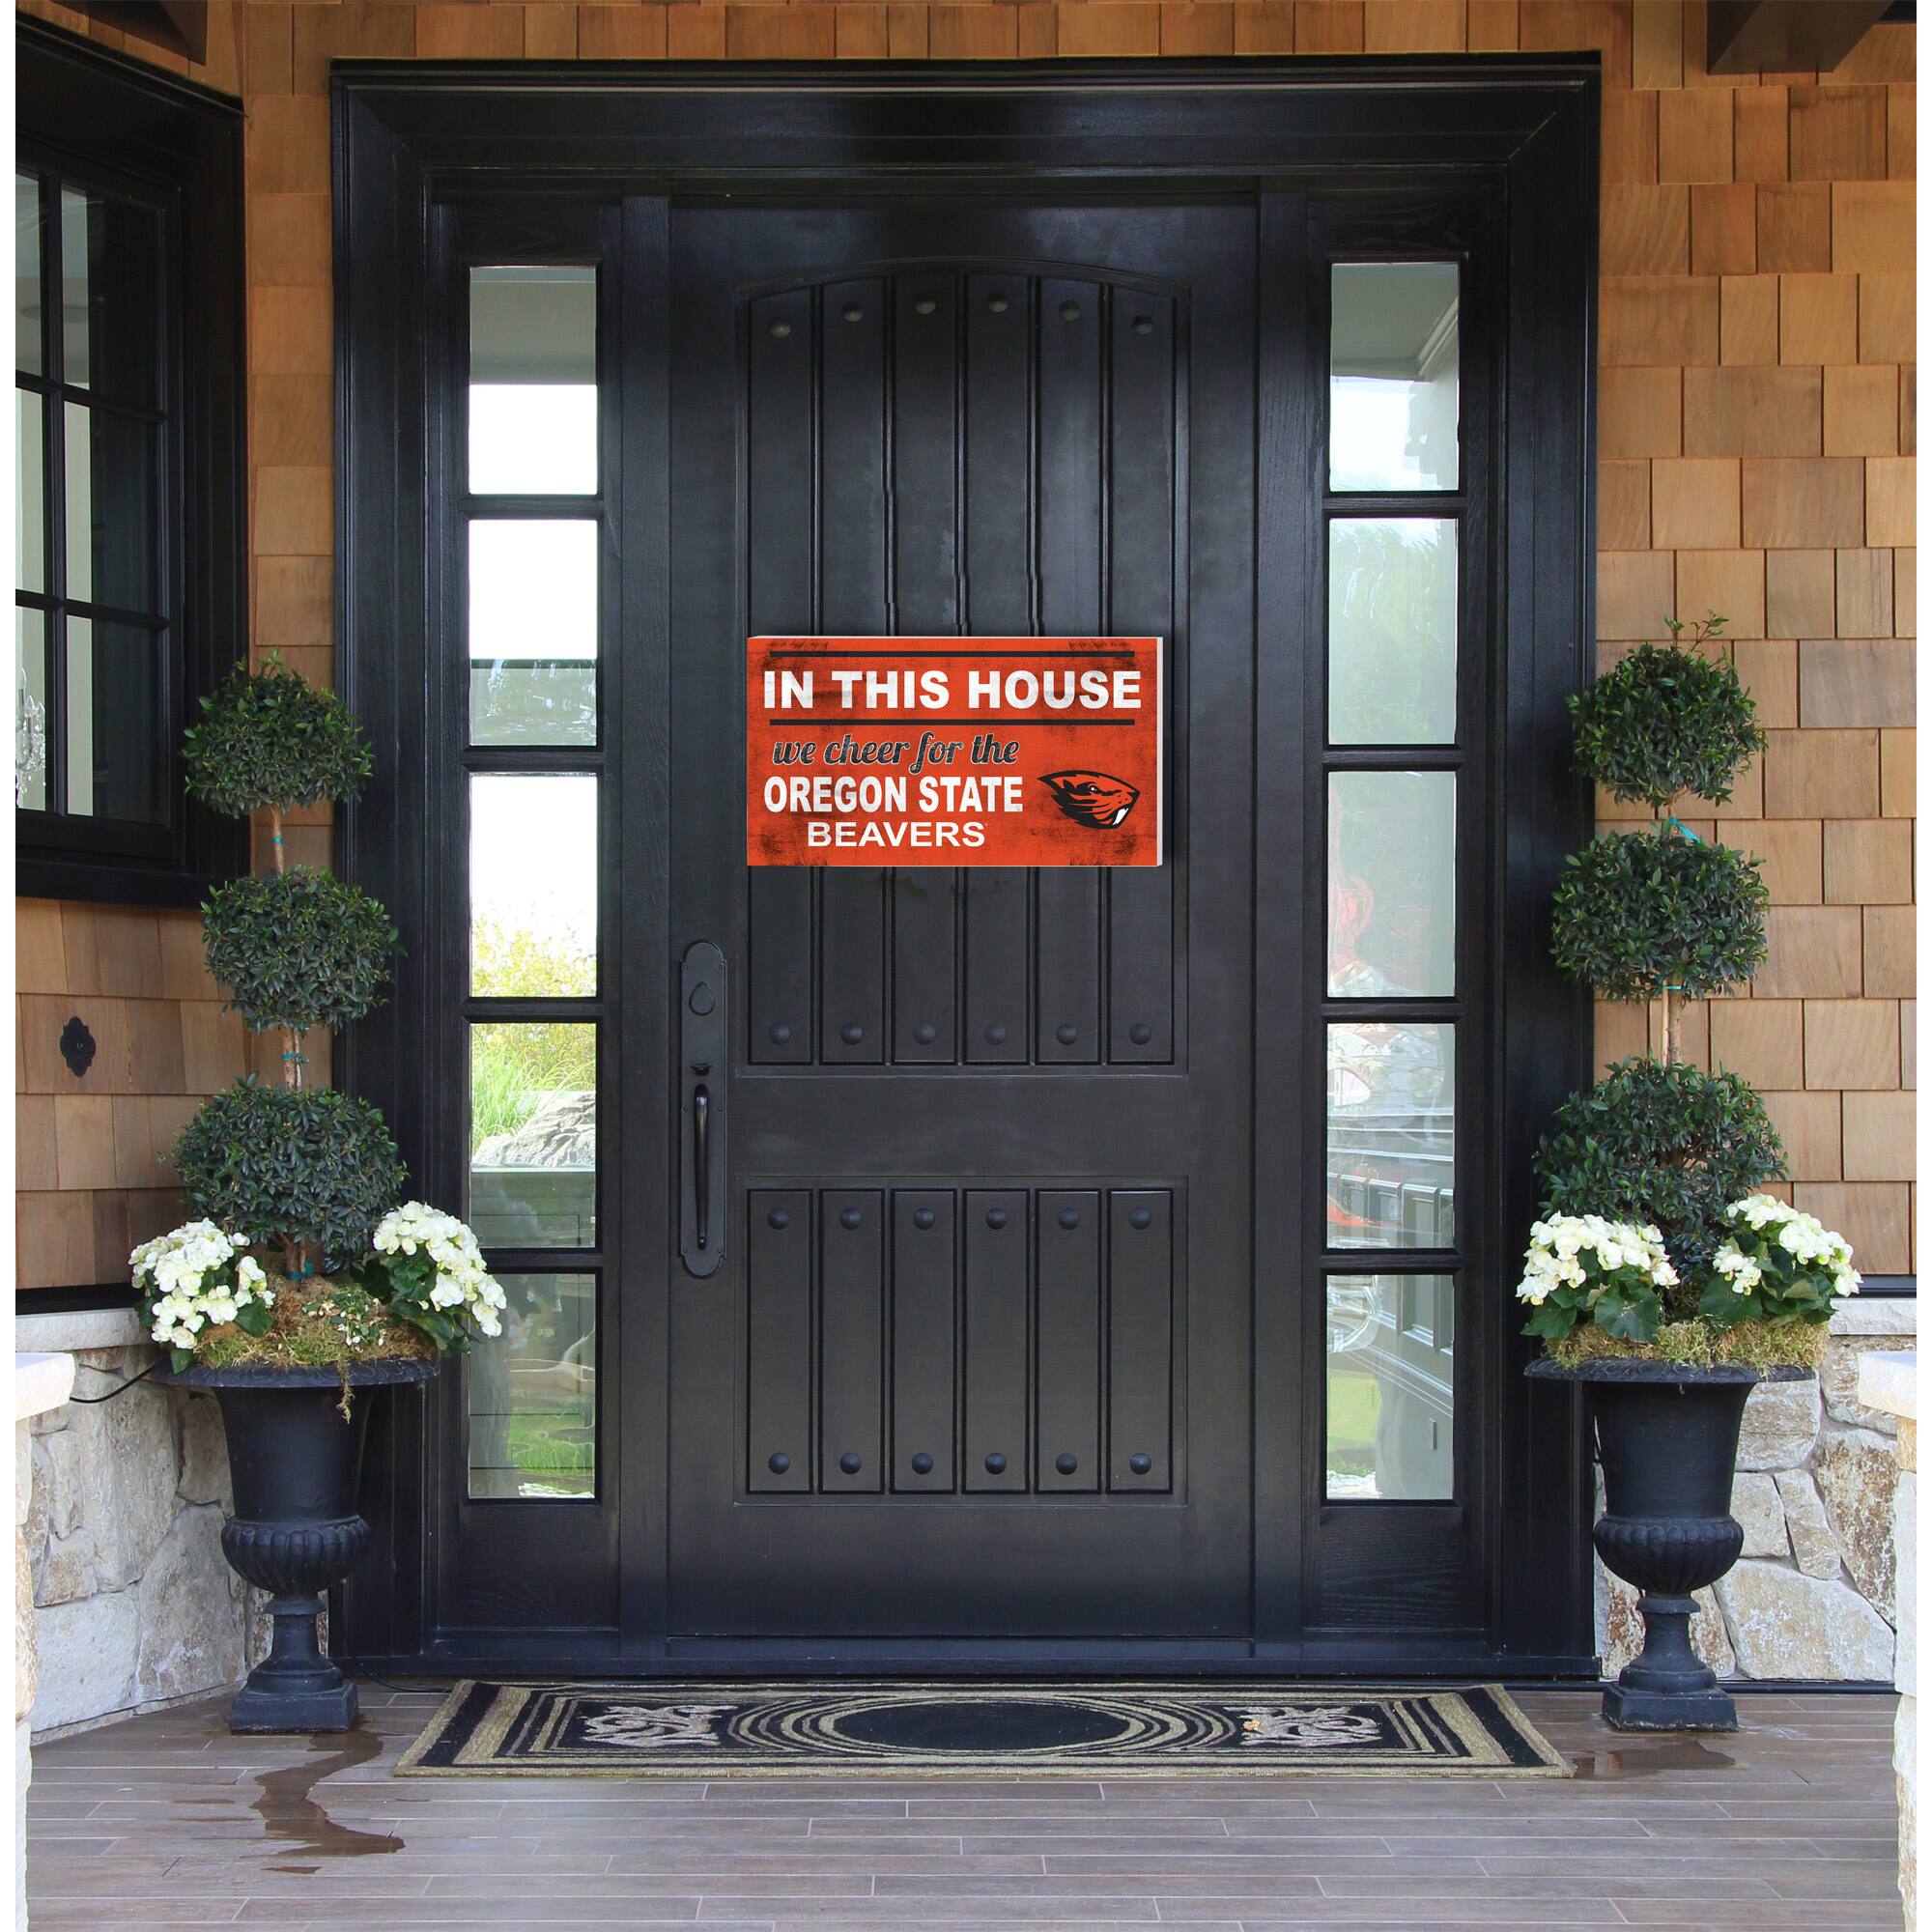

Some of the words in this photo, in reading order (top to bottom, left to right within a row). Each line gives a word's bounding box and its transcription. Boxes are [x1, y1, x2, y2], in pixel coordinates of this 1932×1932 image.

[764, 670, 813, 709] IN
[832, 669, 950, 710] THIS
[968, 669, 1142, 710] HOUSE
[772, 737, 817, 765] we
[823, 733, 911, 765] cheer
[908, 731, 964, 775] for
[970, 732, 1020, 765] the
[764, 776, 907, 812] OREGON
[919, 776, 1023, 812] STATE
[808, 821, 985, 848] BEAVERS
